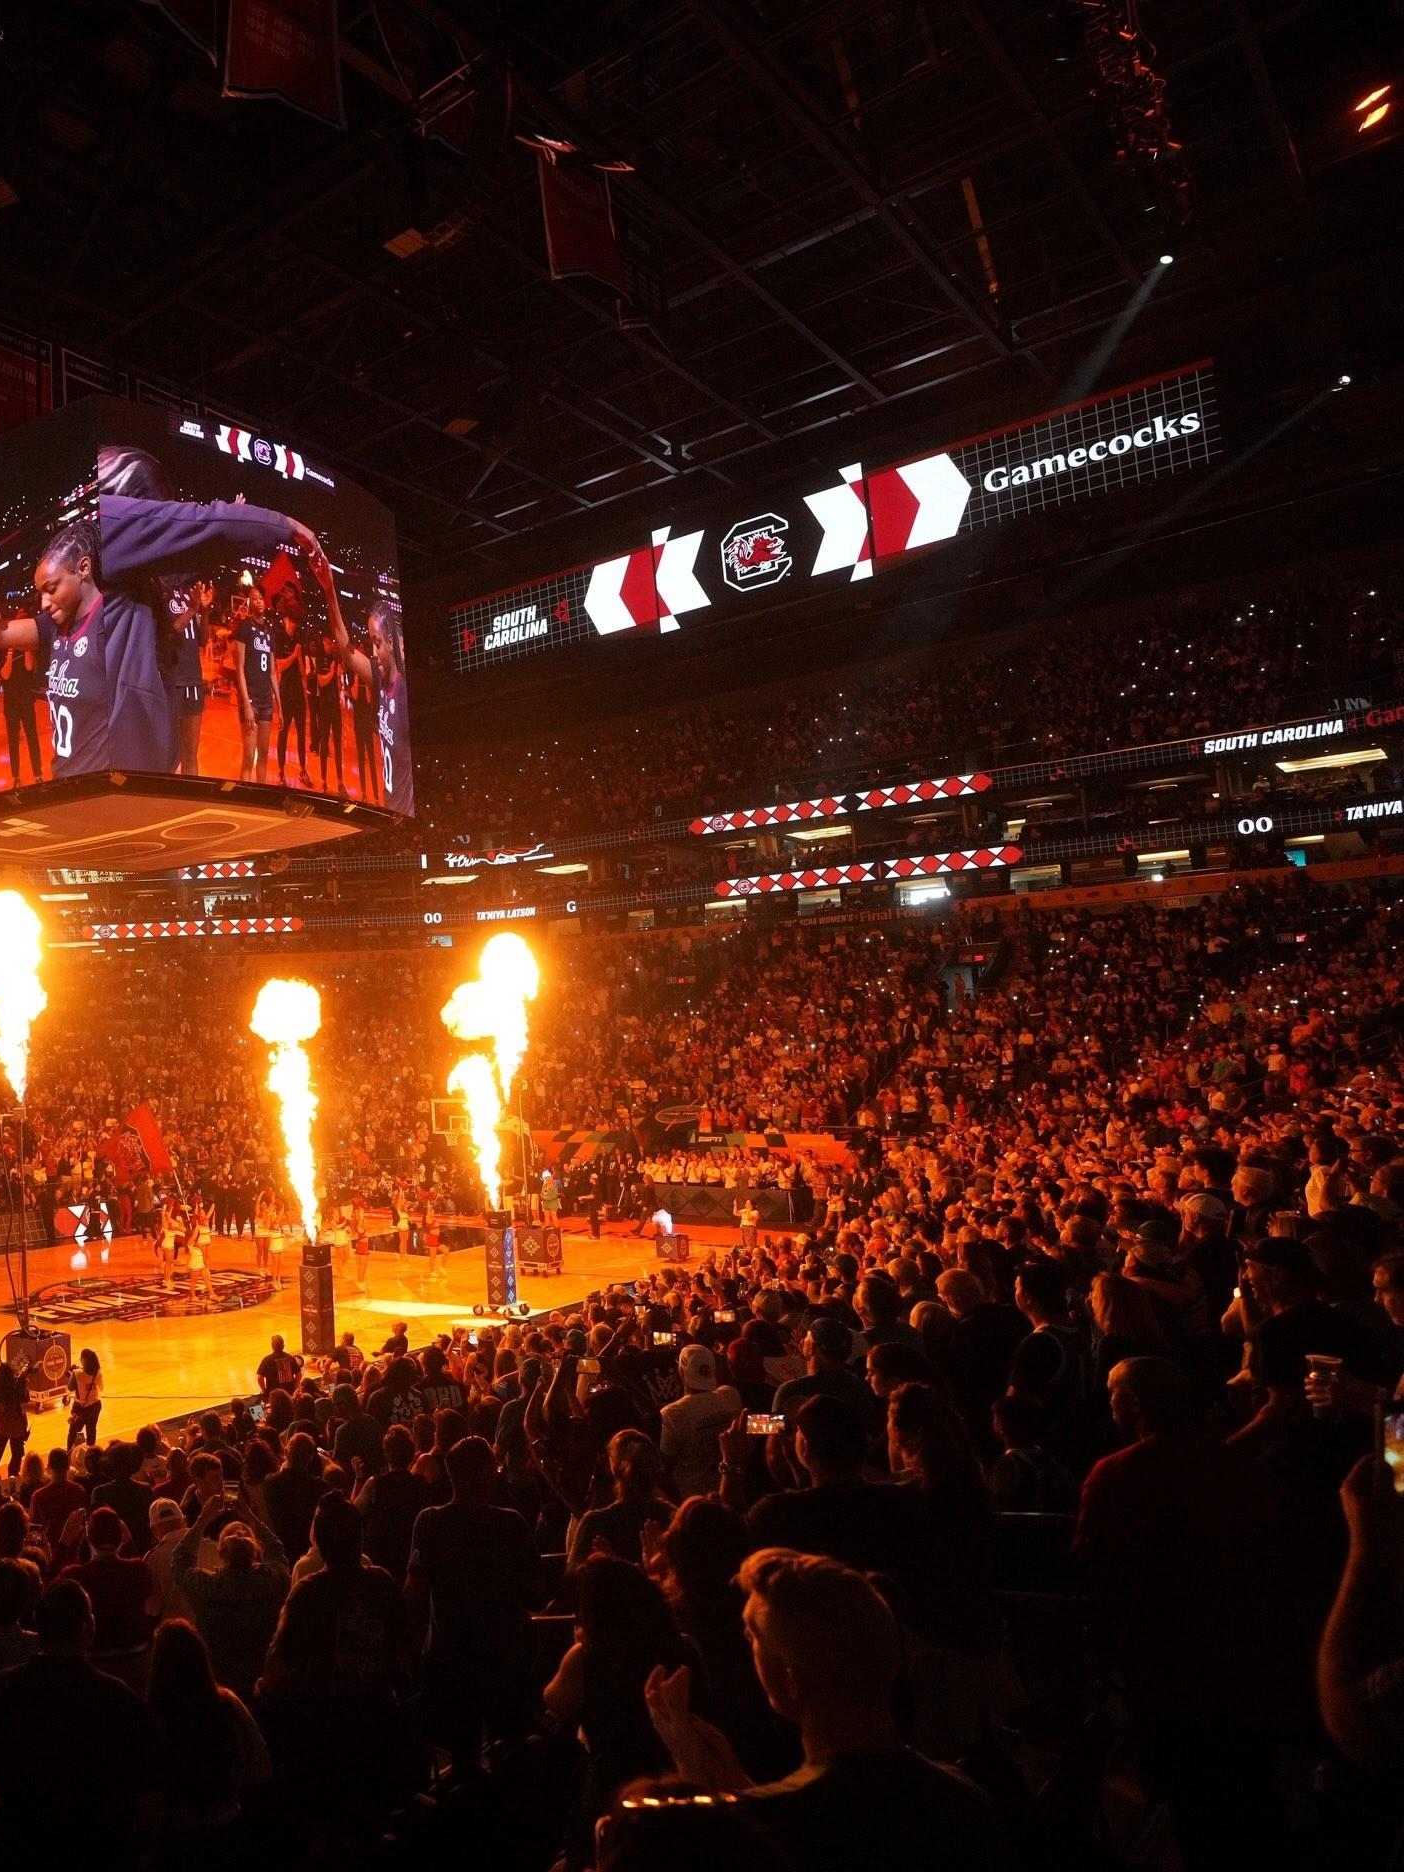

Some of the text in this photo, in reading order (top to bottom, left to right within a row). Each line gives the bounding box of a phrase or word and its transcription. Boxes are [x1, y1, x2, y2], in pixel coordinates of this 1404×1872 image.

[983, 412, 1201, 492] Gamecocks
[305, 466, 335, 488] Gamecocks
[492, 604, 538, 633] SOUTH
[484, 618, 549, 651] CAROLINA
[260, 653, 268, 671] 8
[1203, 733, 1258, 755] SOUTH
[1261, 718, 1344, 746] CAROLINA
[1237, 799, 1403, 835] 00 TA'NIYA
[424, 901, 579, 924] 00 TA'NIYA LATSON G
[818, 913, 854, 925] WOMEN'S
[858, 908, 892, 923] Final
[27, 1291, 159, 1319] FINAL
